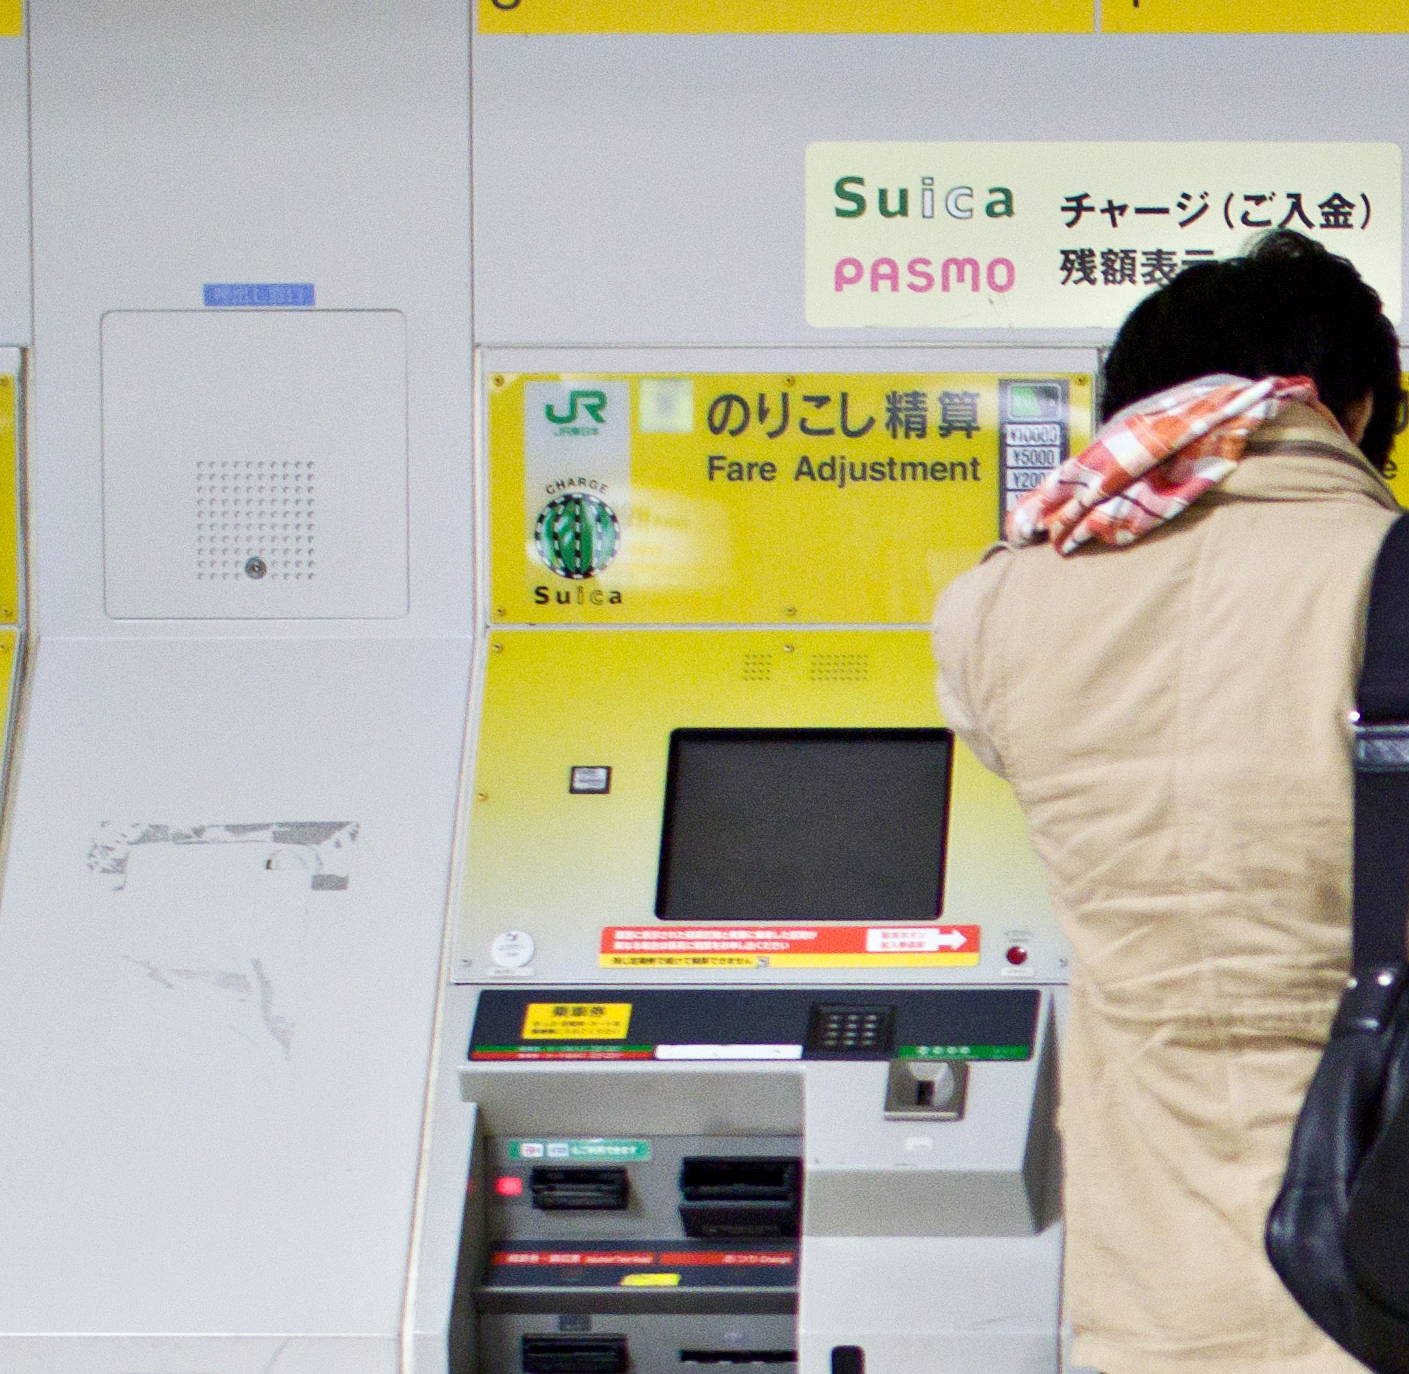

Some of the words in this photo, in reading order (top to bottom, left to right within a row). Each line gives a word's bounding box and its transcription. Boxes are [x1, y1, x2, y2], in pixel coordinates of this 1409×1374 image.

[834, 176, 1015, 219] Suica
[1061, 192, 1370, 229] チャージ（ご入金）
[834, 257, 1015, 293] PASMO
[544, 390, 607, 424] JR
[708, 390, 981, 439] のりこし精算
[545, 477, 609, 495] CHARGE
[708, 455, 777, 481] Fare
[794, 455, 981, 488] Adjustment
[534, 585, 622, 605] Suica
